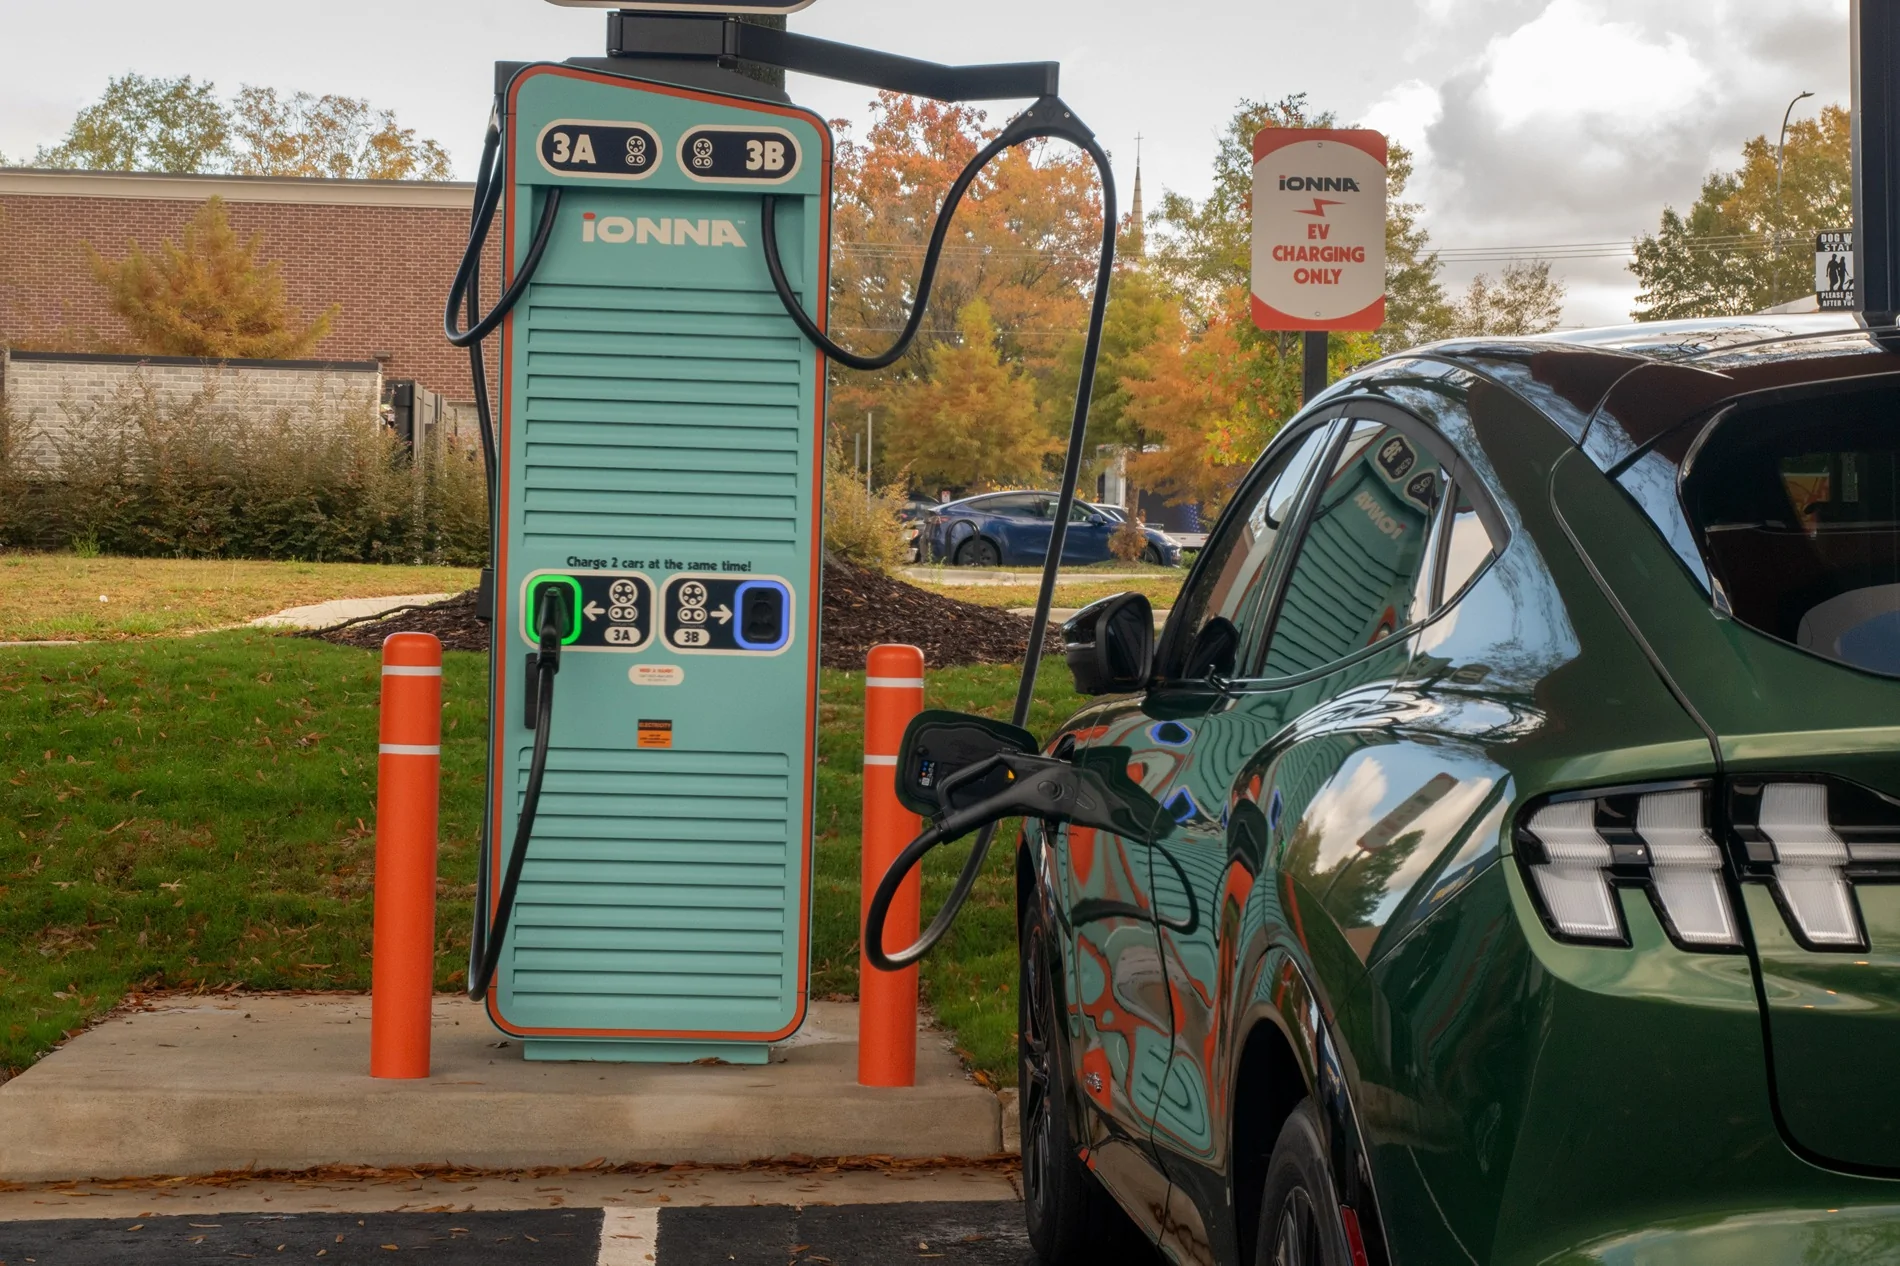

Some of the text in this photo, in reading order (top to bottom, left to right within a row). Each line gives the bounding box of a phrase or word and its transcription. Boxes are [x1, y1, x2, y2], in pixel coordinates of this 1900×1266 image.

[552, 132, 596, 164] 3A
[745, 140, 785, 171] 3B
[1307, 223, 1330, 239] EV
[1821, 233, 1840, 243] DOG
[1272, 245, 1365, 263] CHARGING
[1824, 243, 1850, 252] STAT
[1293, 268, 1342, 285] ONLY
[1821, 291, 1844, 299] PLEASE
[566, 556, 752, 572] Charge 2 cars at the same time!
[613, 629, 631, 641] 3A
[683, 631, 700, 643] 3B
